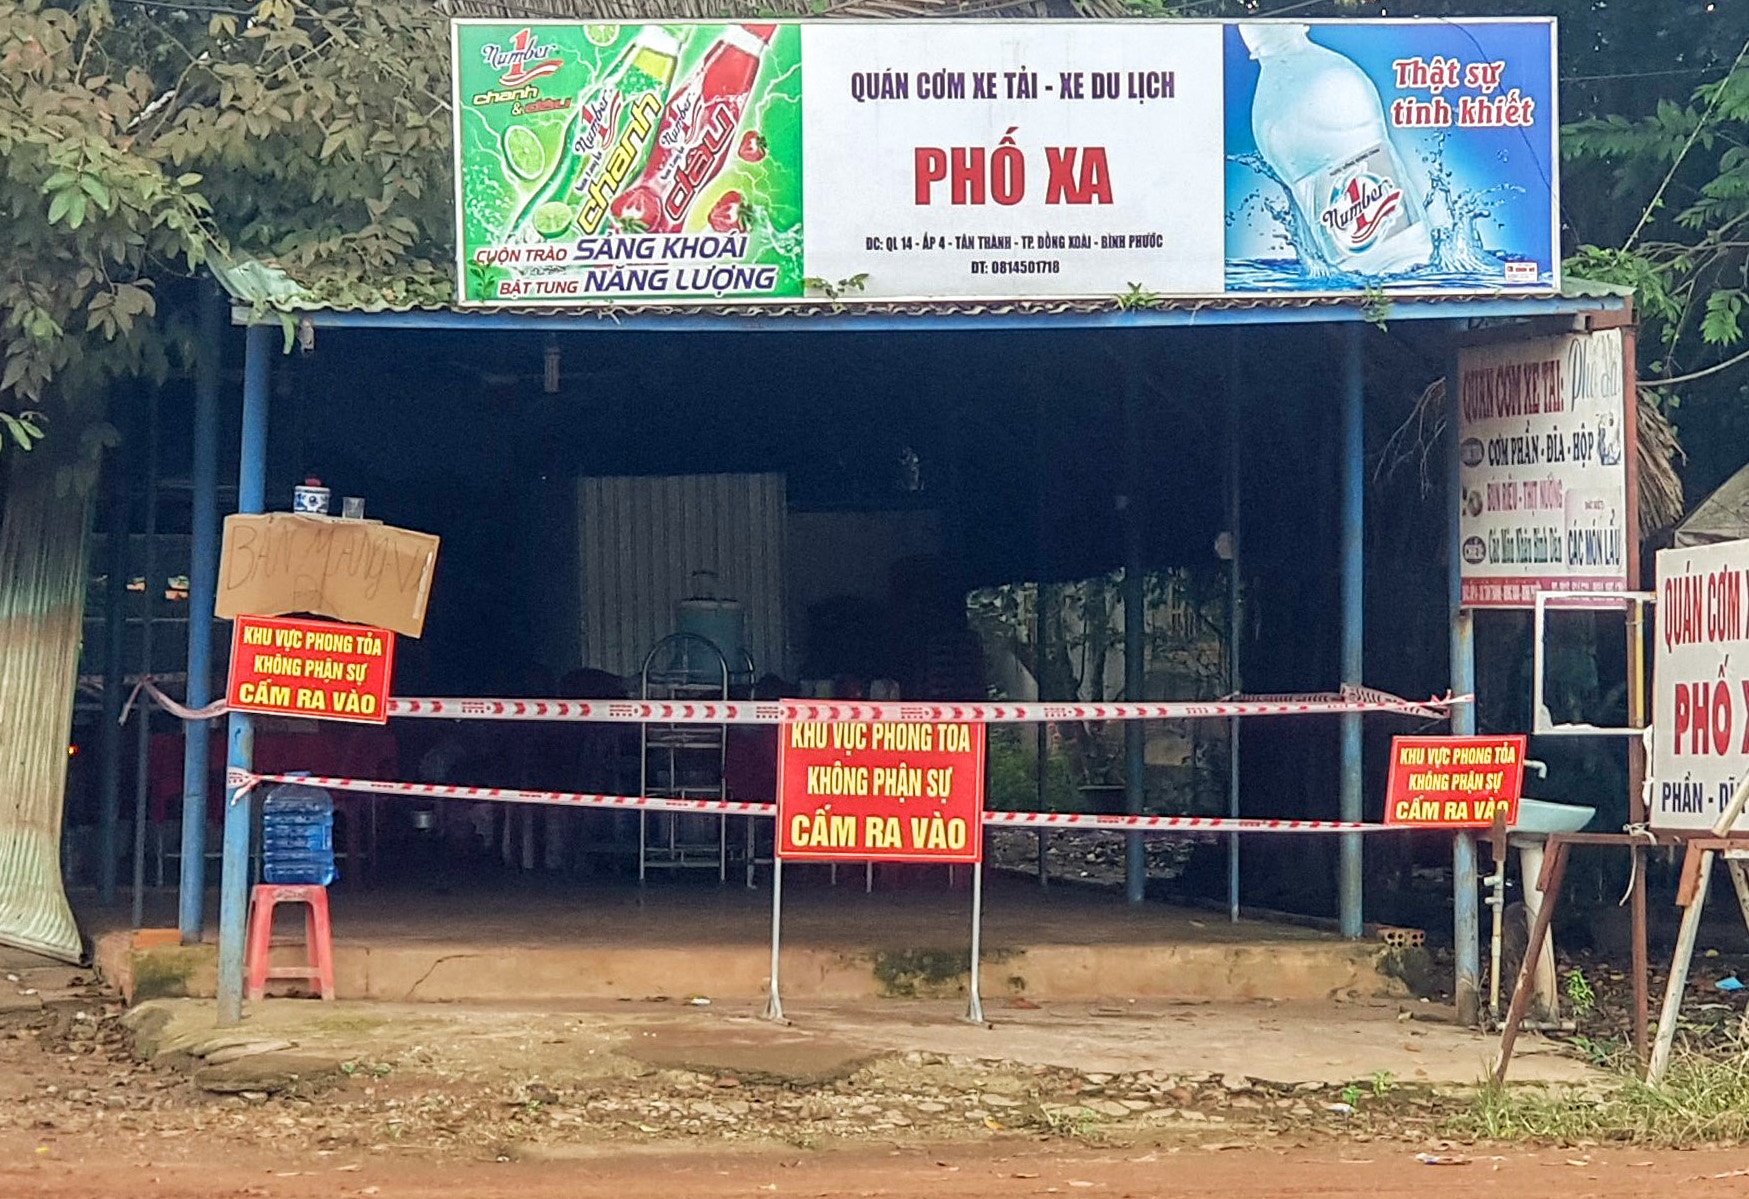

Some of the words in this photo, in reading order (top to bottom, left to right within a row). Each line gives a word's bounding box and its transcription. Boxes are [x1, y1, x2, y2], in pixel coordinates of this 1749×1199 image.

[482, 37, 556, 69] Number
[851, 68, 909, 102] QUÁN
[917, 68, 965, 99] CƠM
[973, 72, 997, 99] XE
[1004, 65, 1037, 99] TẢI
[1060, 72, 1084, 99] XE
[1092, 72, 1120, 99] DU
[1128, 71, 1174, 104] LỊCH
[1395, 58, 1458, 92] Thật
[1467, 63, 1503, 92] sự
[473, 85, 539, 106] chanh
[1460, 91, 1533, 125] khiết
[576, 93, 662, 235] chanh
[914, 126, 1025, 206] PHỐ
[1045, 147, 1114, 205] XA
[1322, 179, 1394, 231] Number
[573, 231, 656, 260] SẢNG
[661, 231, 748, 259] KHOÁI
[886, 236, 899, 252] QL
[901, 236, 912, 250] 14
[939, 236, 946, 250] 4
[584, 265, 669, 292] NĂNG
[675, 264, 776, 296] LƯỢNG
[991, 261, 1060, 274] 0814501718
[536, 281, 579, 294] TUNG
[1665, 560, 1703, 654] QUÁN
[1708, 564, 1740, 642] CƠM
[244, 626, 273, 645] KHU
[275, 629, 303, 652] VỰC
[305, 632, 353, 653] PHONG
[356, 631, 382, 656] TỎA
[254, 653, 302, 676] KHÔNG
[304, 657, 344, 683] PHẬN
[346, 662, 368, 686] SỰ
[239, 678, 291, 707] CẤM
[296, 688, 326, 710] RA
[333, 688, 376, 714] VÀO
[1674, 653, 1732, 756] PHỐ
[791, 721, 827, 749] KHU
[872, 723, 933, 752] PHONG
[1400, 747, 1425, 764] KHU
[1427, 747, 1451, 768] VỰC
[1453, 747, 1493, 764] PHONG
[1495, 742, 1516, 764] TỎA
[807, 761, 868, 796] KHÔNG
[873, 762, 922, 803] PHẬN
[926, 767, 953, 804] SỰ
[1409, 770, 1449, 790] KHÔNG
[1451, 770, 1484, 794] PHẬN
[1485, 771, 1504, 794] SỰ
[1396, 795, 1440, 820] CẤM
[1444, 801, 1468, 820] RA
[791, 804, 857, 848] CẤM
[865, 816, 902, 849] RA
[911, 811, 967, 850] VÀO
